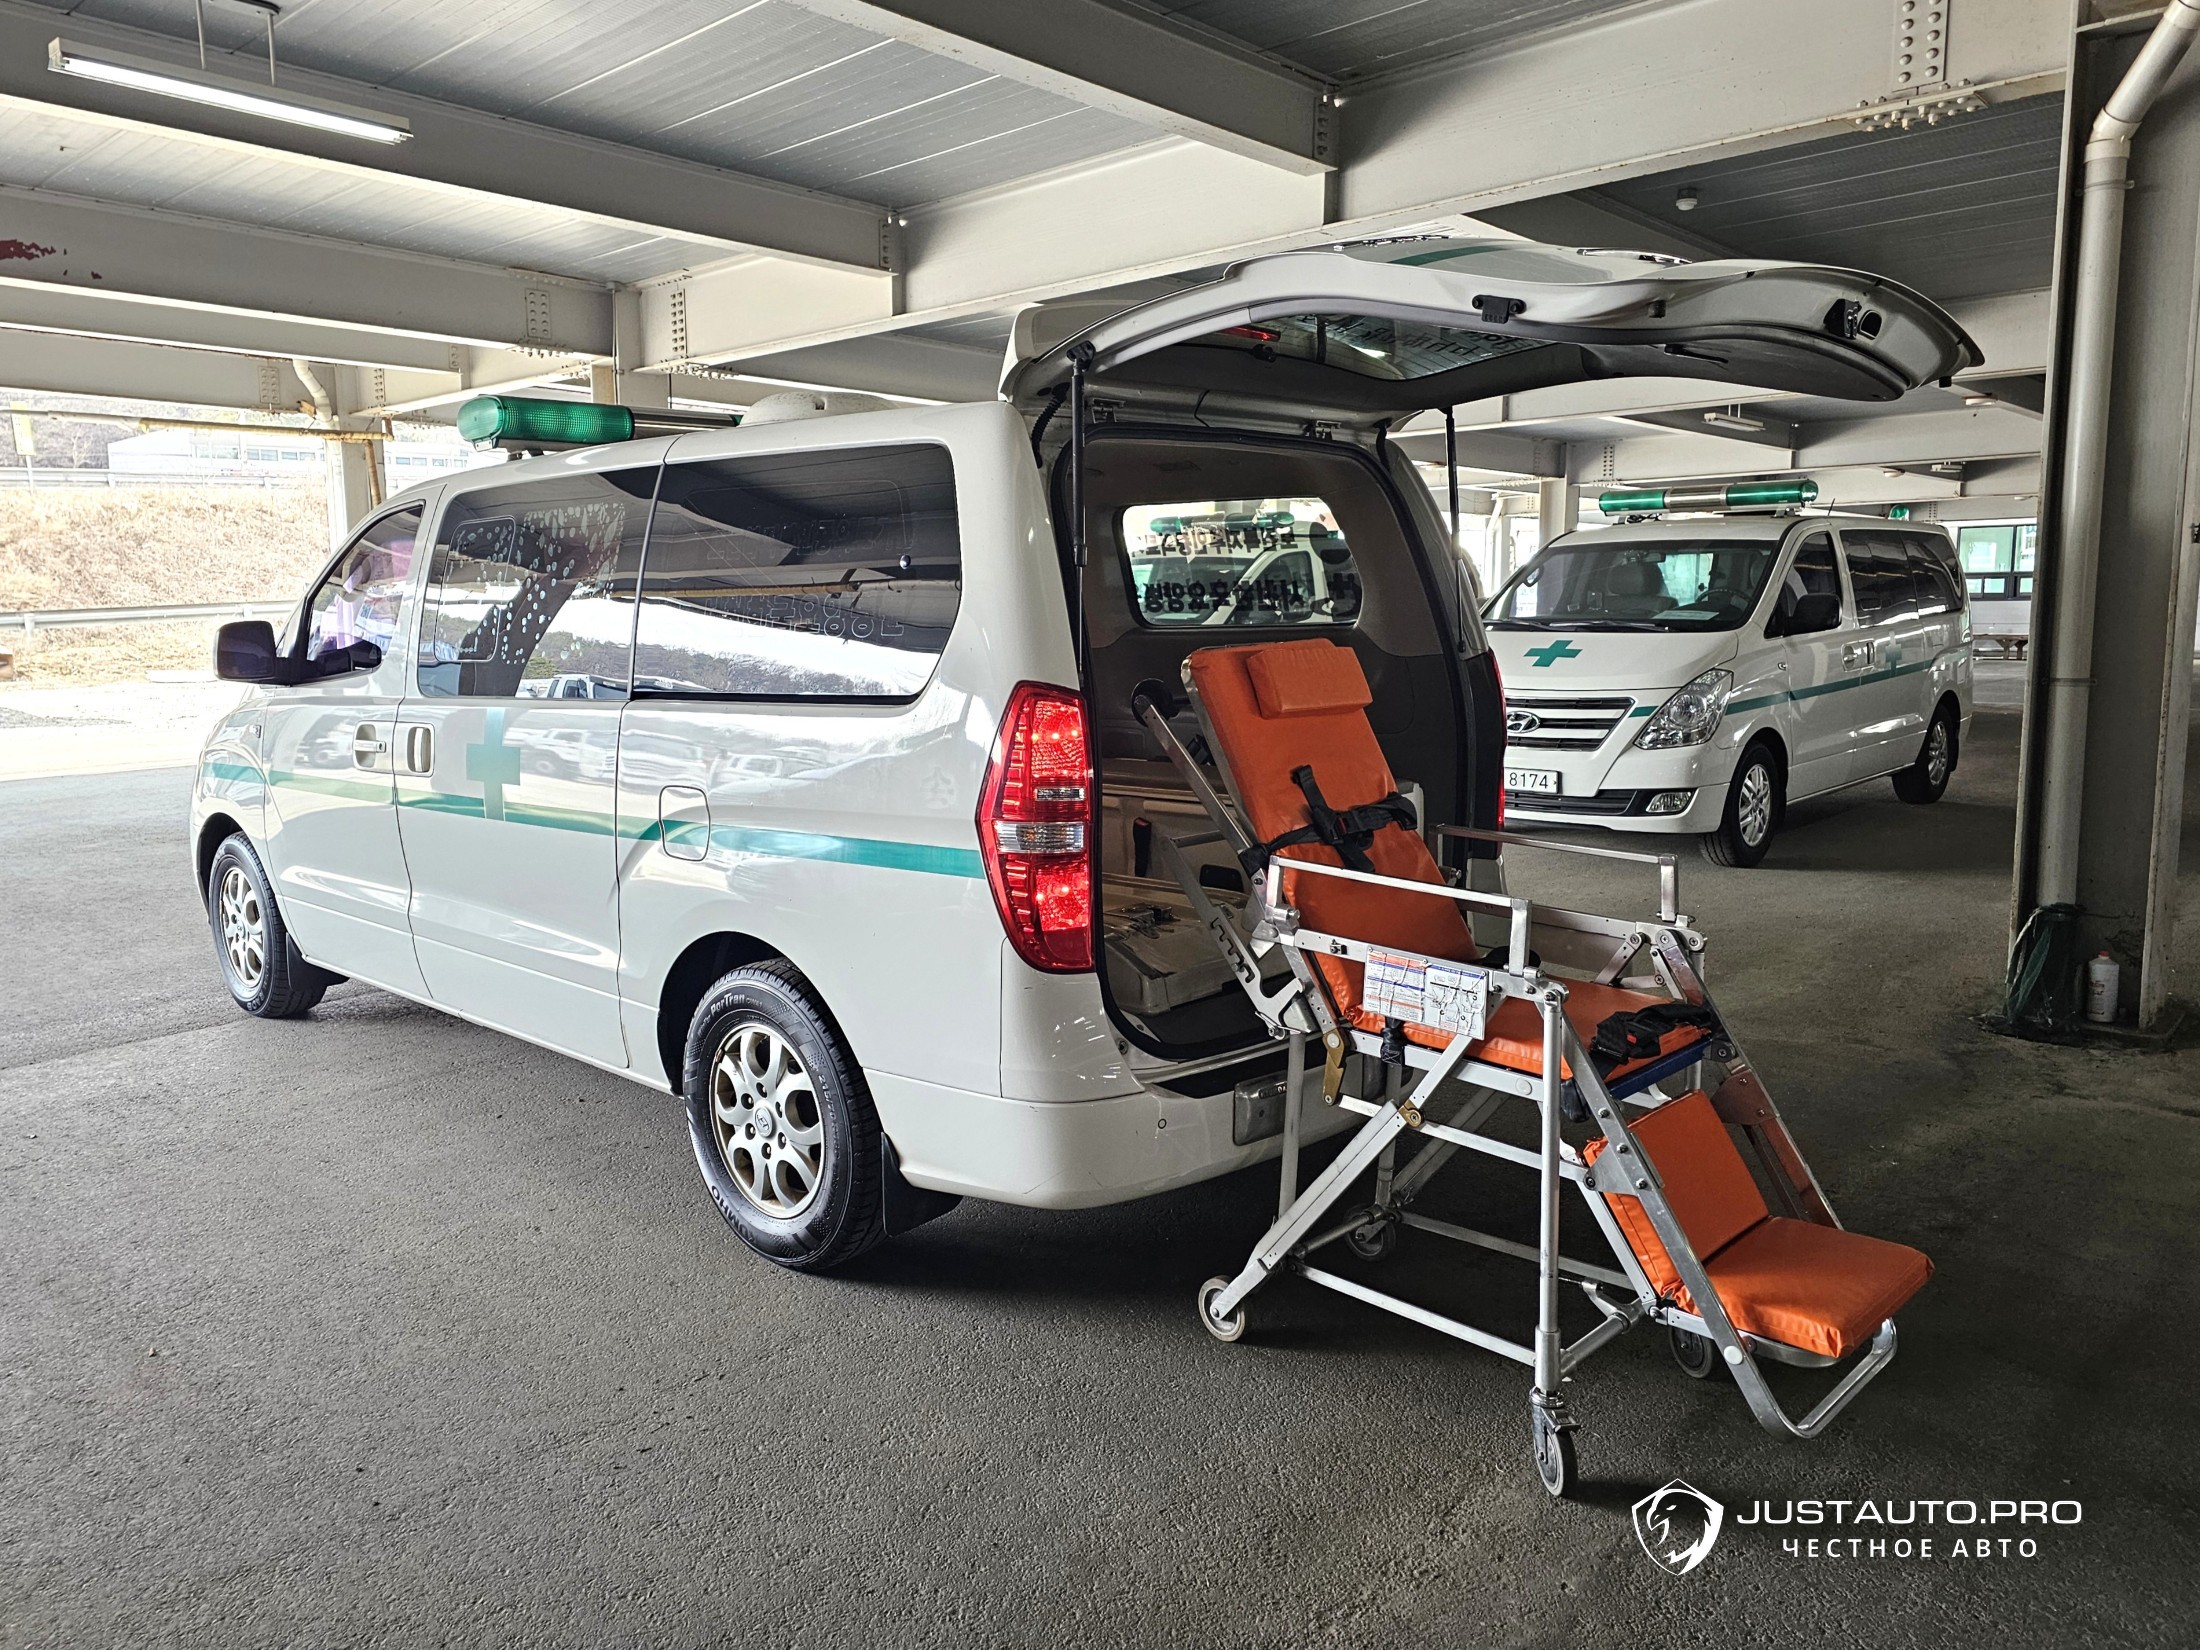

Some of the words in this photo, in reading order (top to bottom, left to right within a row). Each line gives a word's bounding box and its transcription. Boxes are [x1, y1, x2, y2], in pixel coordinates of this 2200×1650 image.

[1509, 772, 1549, 790] 8174
[710, 992, 745, 1016] PorTran
[711, 1185, 755, 1243] KUMHO
